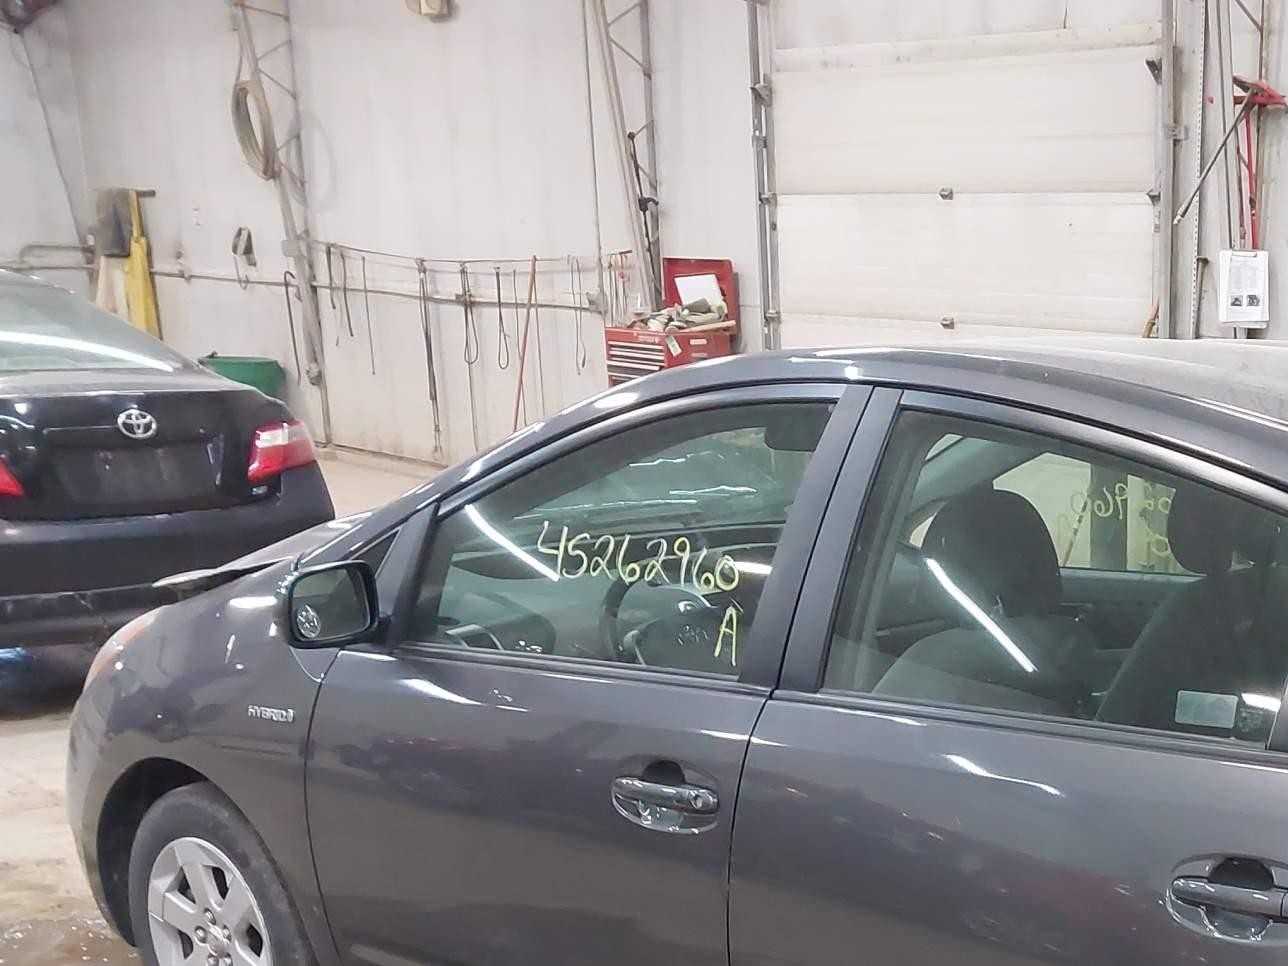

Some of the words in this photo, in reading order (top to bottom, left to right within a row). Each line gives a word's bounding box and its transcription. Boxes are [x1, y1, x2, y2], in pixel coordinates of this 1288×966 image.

[537, 520, 740, 595] 45262960
[714, 606, 738, 668] A
[247, 705, 287, 722] HYBRID
